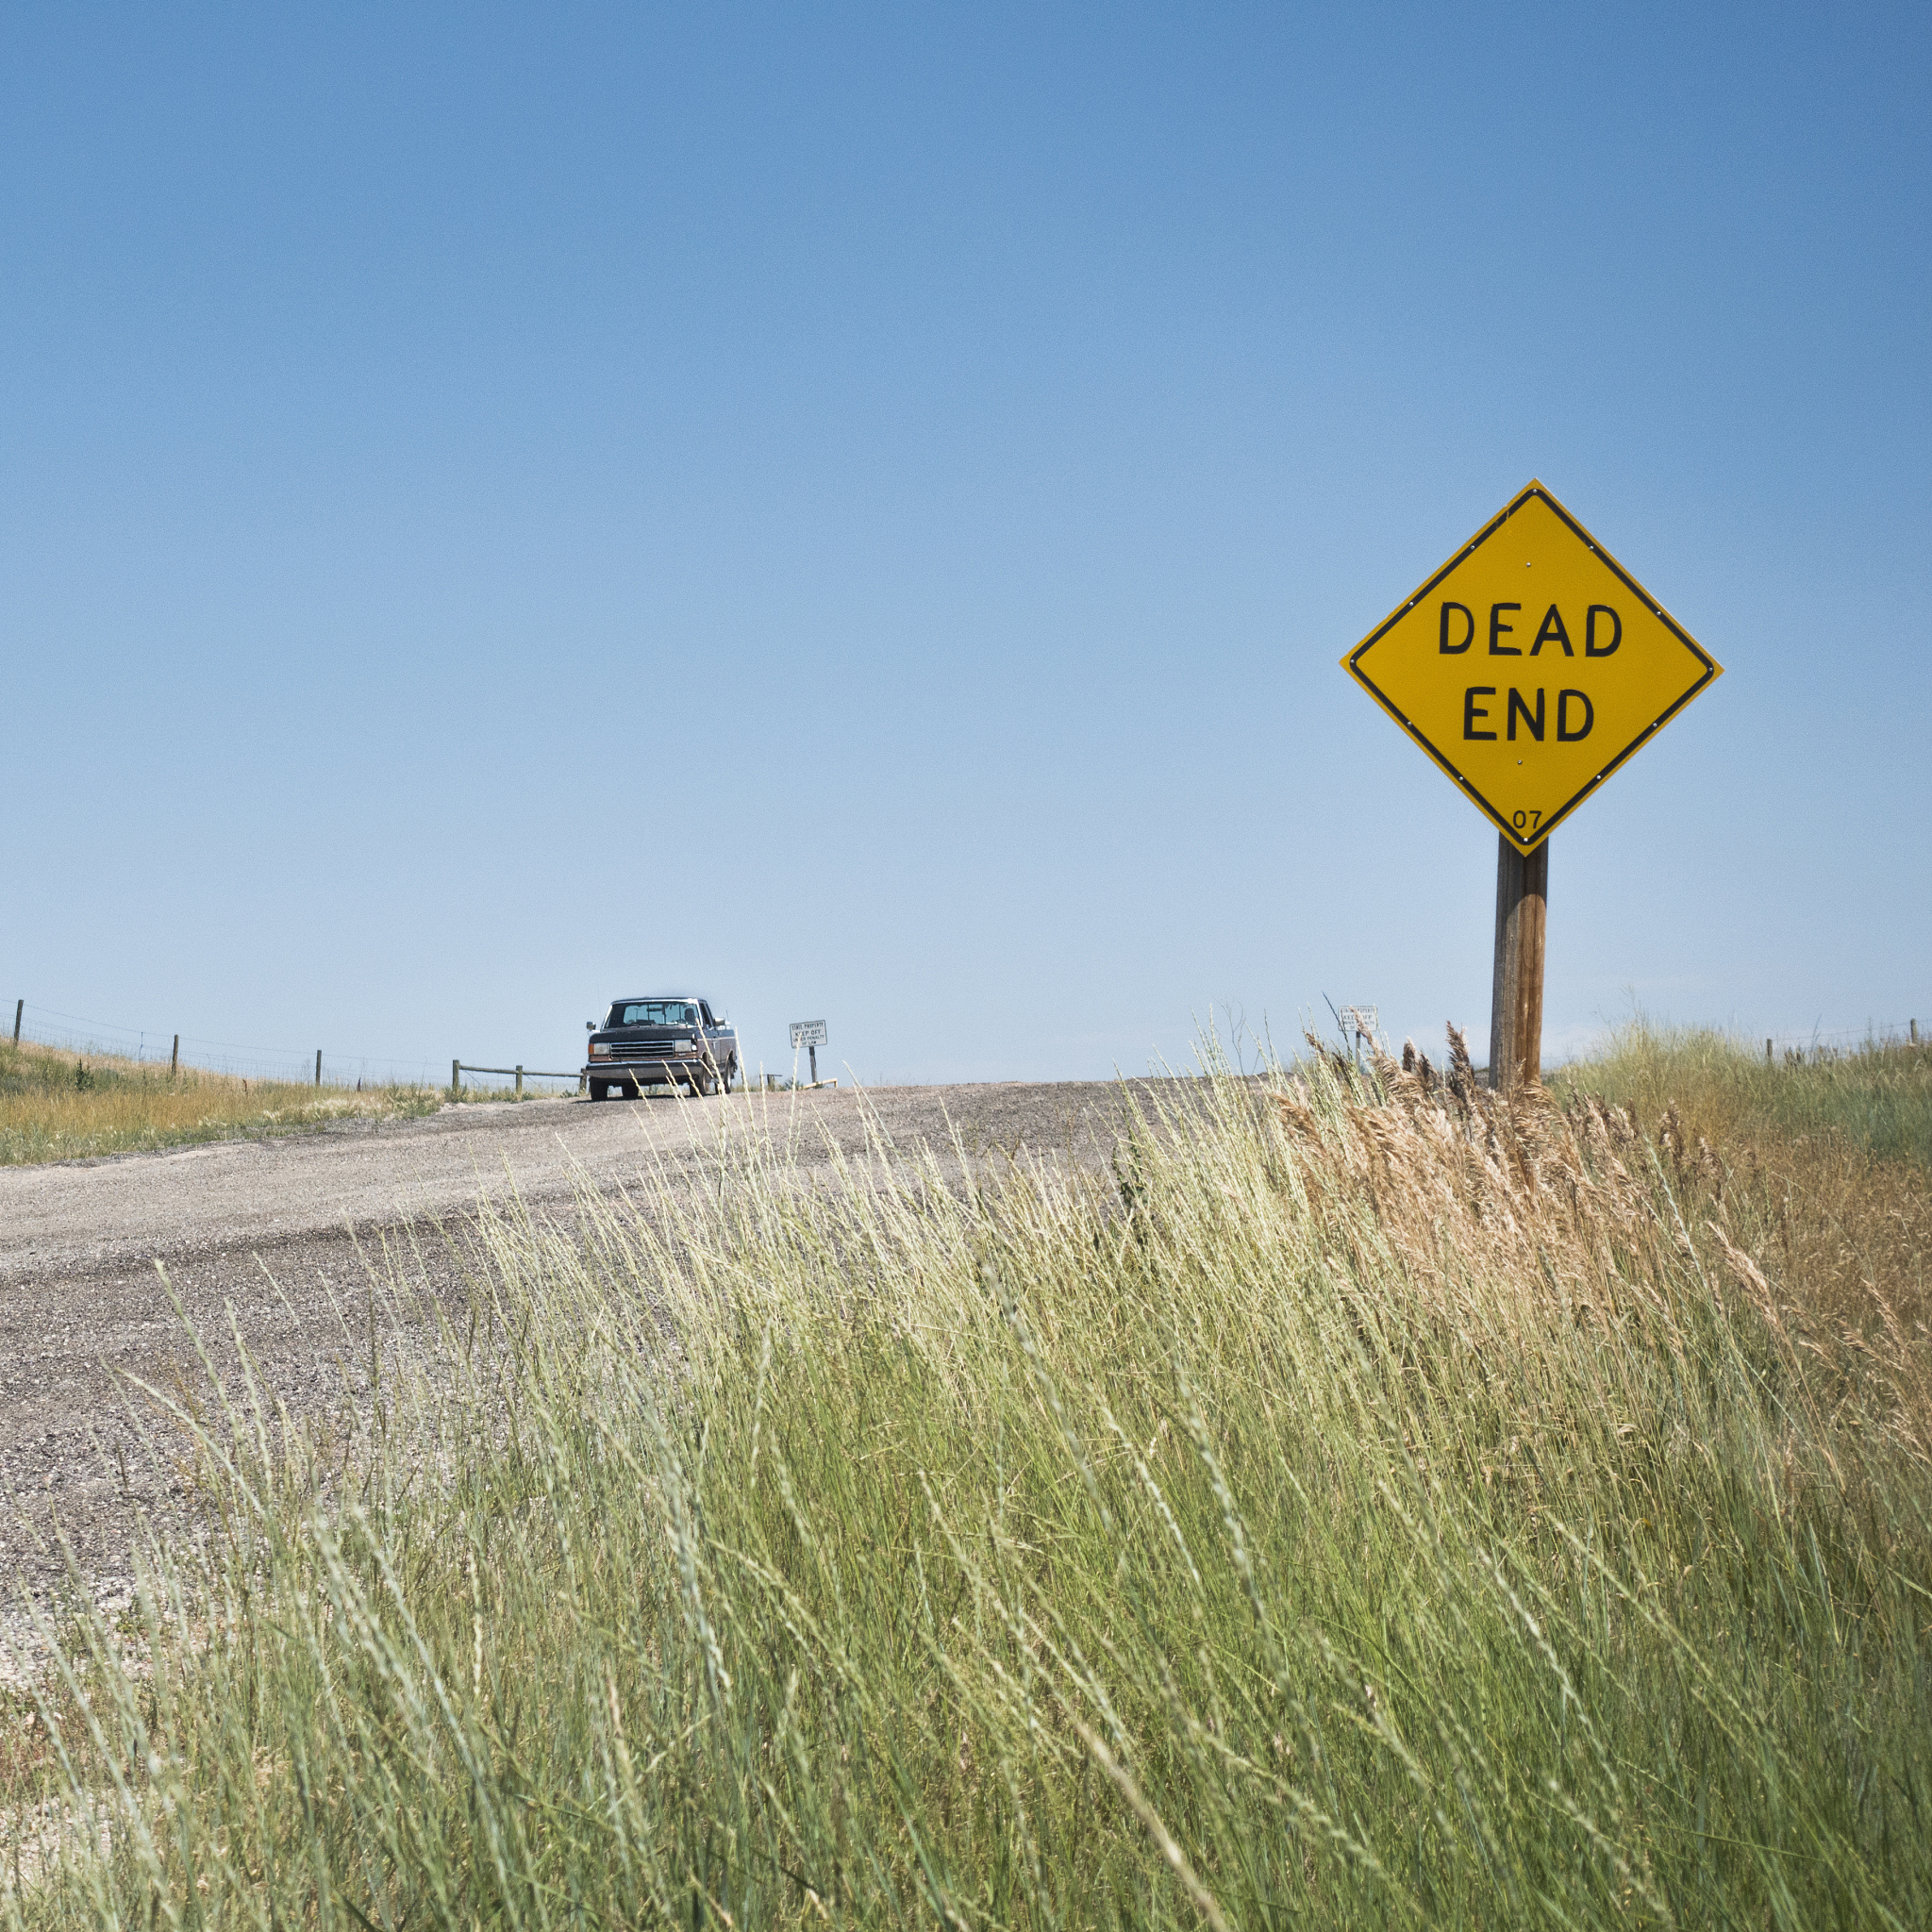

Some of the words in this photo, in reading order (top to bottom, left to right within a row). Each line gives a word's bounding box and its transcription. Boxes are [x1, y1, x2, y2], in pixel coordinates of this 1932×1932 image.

[1439, 602, 1622, 658] DEAD
[1463, 686, 1594, 741] END
[1512, 809, 1542, 829] 07
